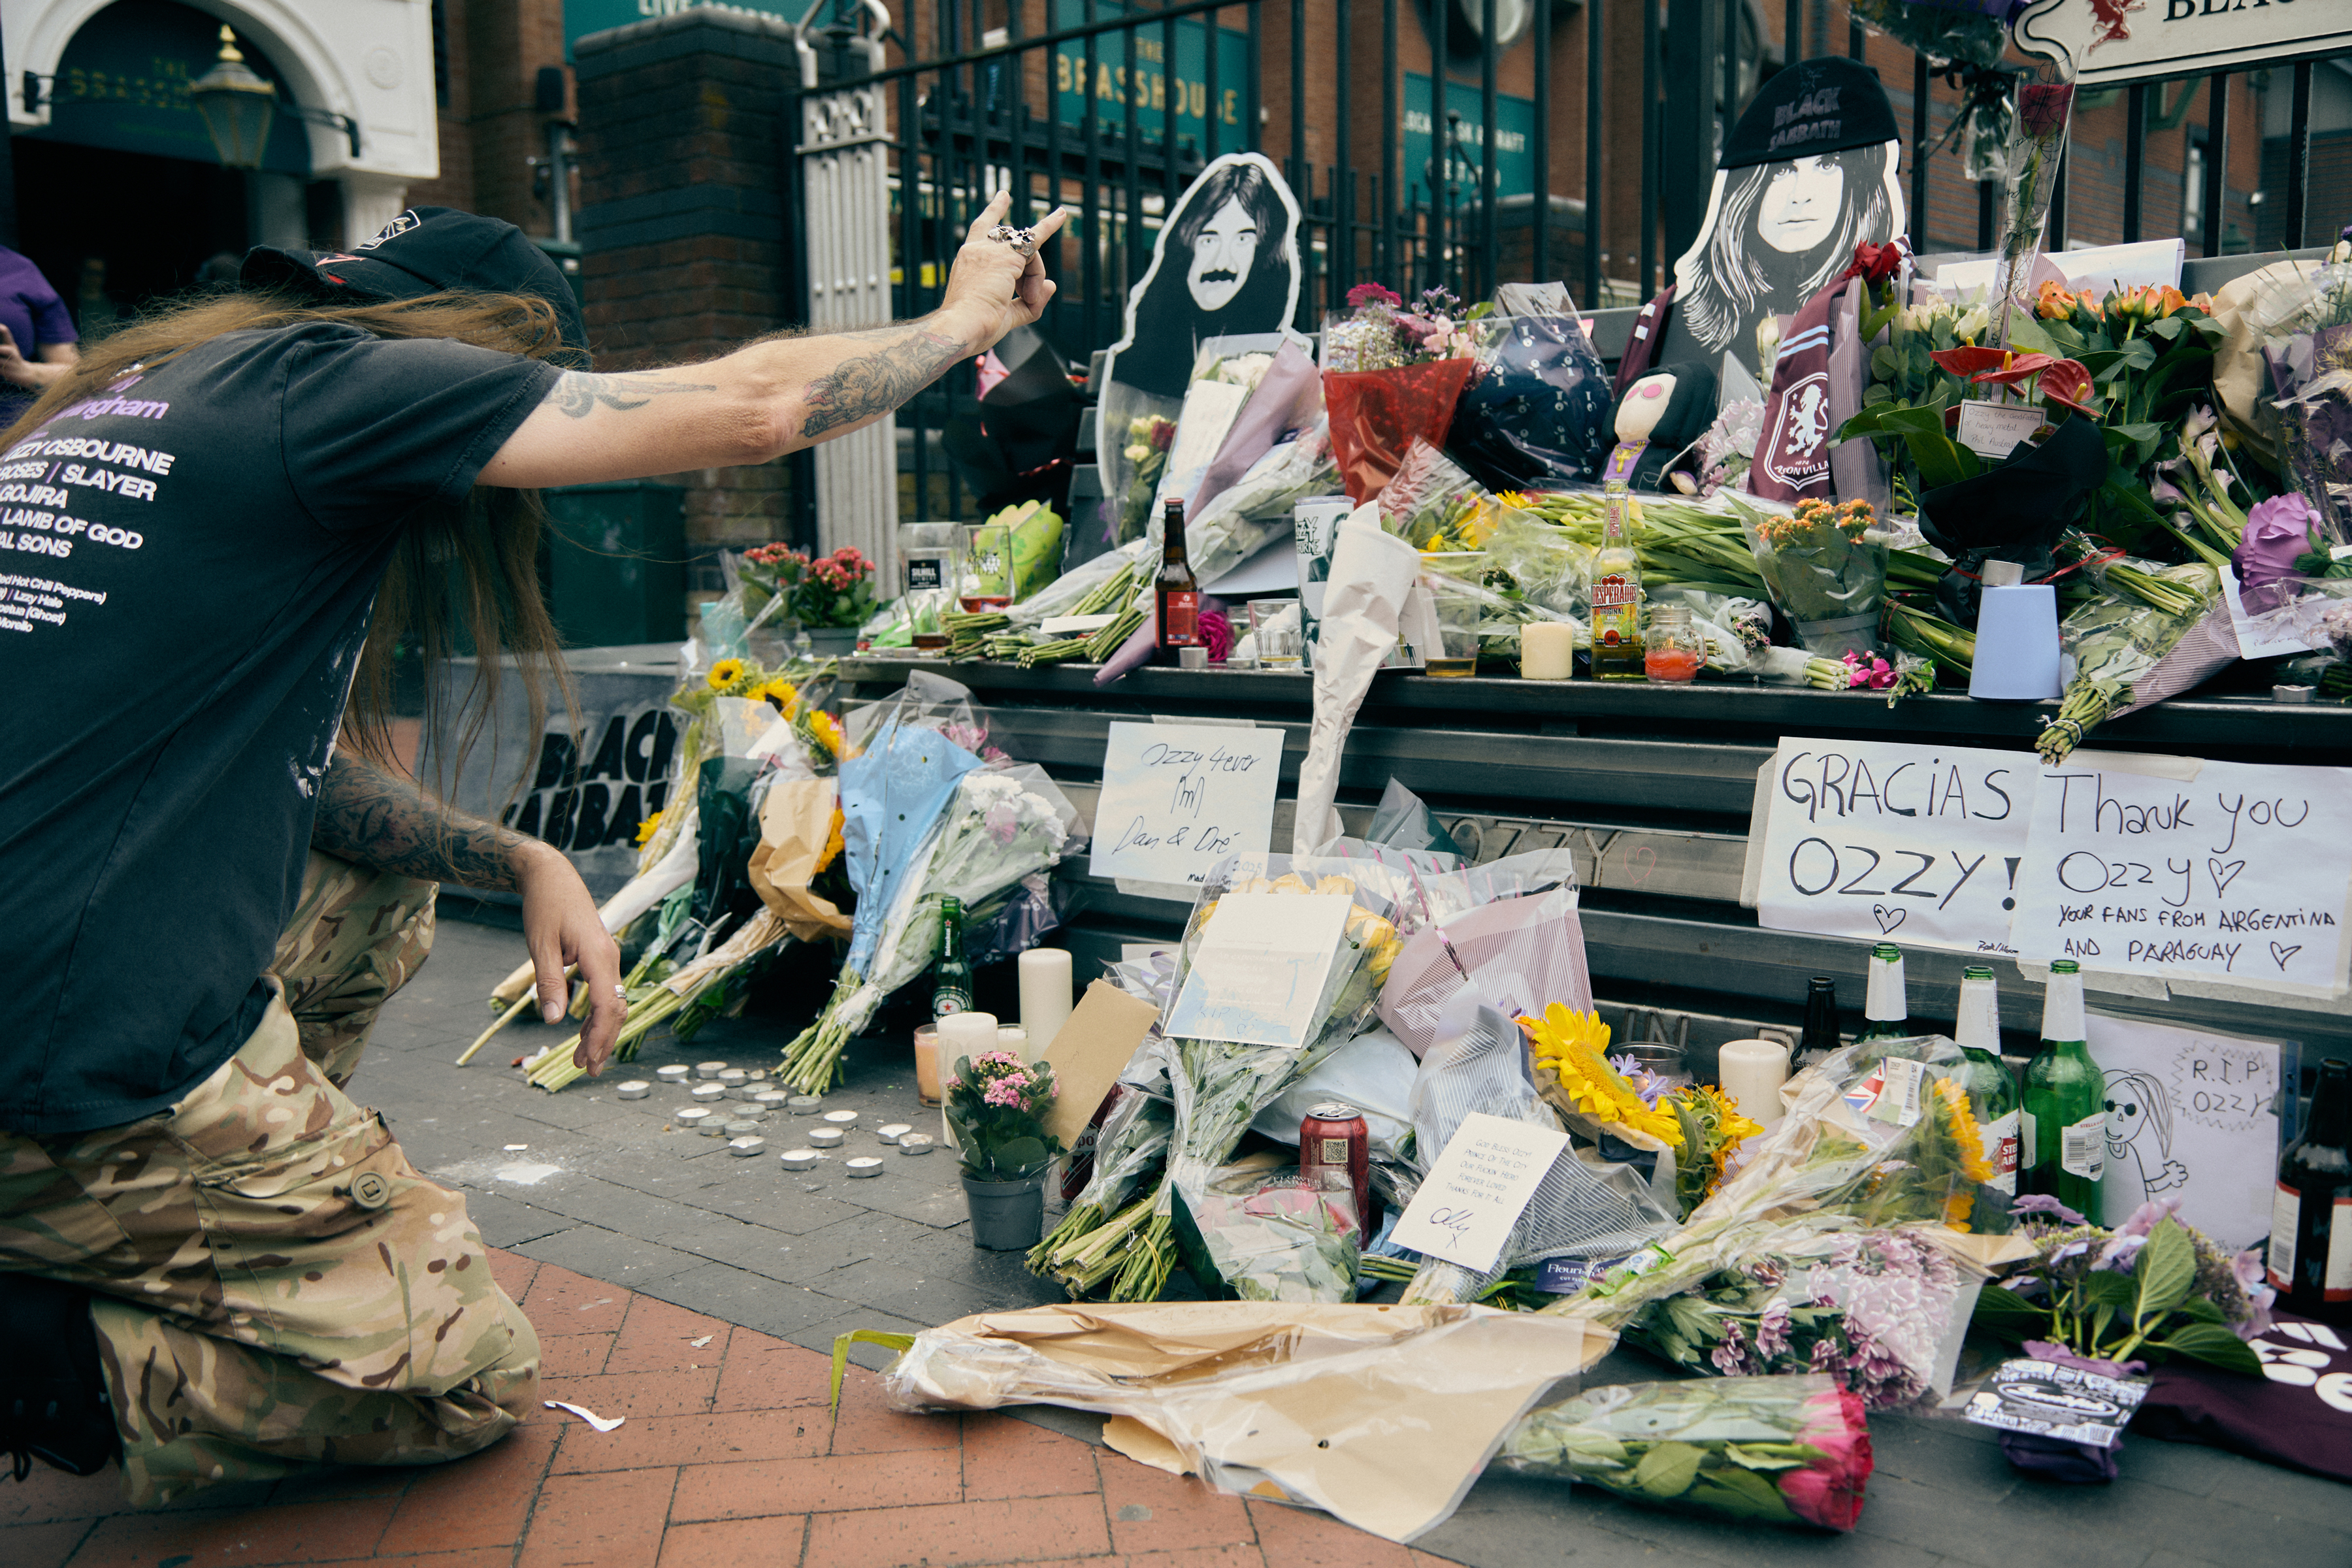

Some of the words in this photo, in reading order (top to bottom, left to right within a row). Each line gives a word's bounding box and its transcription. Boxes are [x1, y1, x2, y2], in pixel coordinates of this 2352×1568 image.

[1773, 87, 1842, 129] BLACK
[1768, 120, 1842, 152] SABBATH
[1968, 408, 1989, 421] Ozzy
[1994, 410, 2006, 419] the
[1975, 421, 1993, 435] heavy
[43, 437, 176, 476] OSBOURNE
[1803, 460, 1829, 475] VILLA
[0, 483, 68, 509] GOJIRA
[61, 464, 157, 502] SLAYER
[3, 508, 55, 530] LAMB
[55, 516, 88, 535] OF
[88, 523, 144, 549] GOD
[17, 533, 73, 558] SONS
[11, 574, 30, 587] Hot
[29, 578, 54, 591] Chili
[53, 581, 106, 605] Peppers)
[37, 593, 63, 609] Hale
[1592, 584, 1637, 606] DESPERADOS
[25, 605, 67, 626] (Ghost)
[2044, 773, 2195, 834] Thank
[1167, 826, 1190, 846] &
[2102, 907, 2148, 923] FANS
[2158, 910, 2206, 928] FROM
[2065, 938, 2100, 958] AND
[2129, 939, 2242, 972] PARAGUAY
[2193, 1090, 2272, 1117] OZZY
